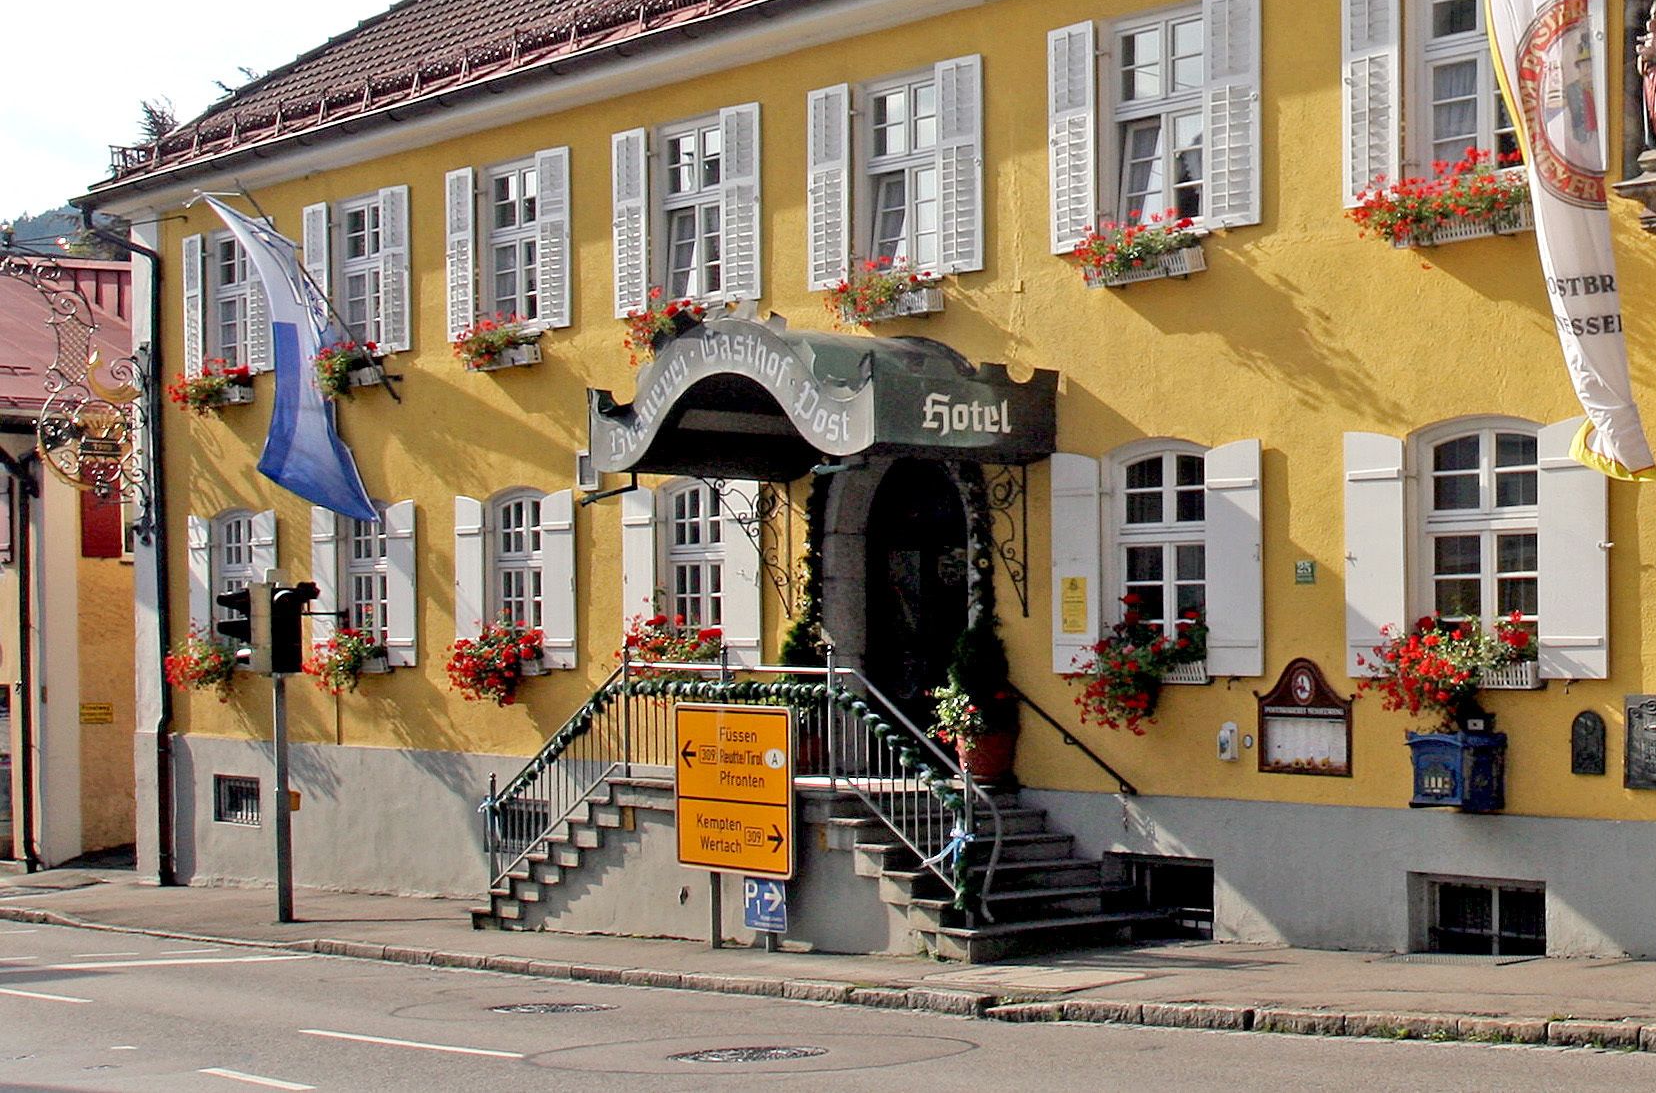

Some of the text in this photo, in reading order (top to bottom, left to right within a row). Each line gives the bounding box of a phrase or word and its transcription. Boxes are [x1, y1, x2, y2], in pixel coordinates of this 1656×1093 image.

[609, 330, 850, 461] Brauerei Gasthof Post
[921, 393, 1012, 436] Hotel
[1297, 561, 1311, 573] 25
[719, 726, 757, 743] Füssen
[701, 748, 779, 766] 309 Reutte/Tirol A
[720, 770, 765, 788] Pfronten
[696, 813, 761, 844] Kempten 309
[700, 835, 742, 853] Wertach
